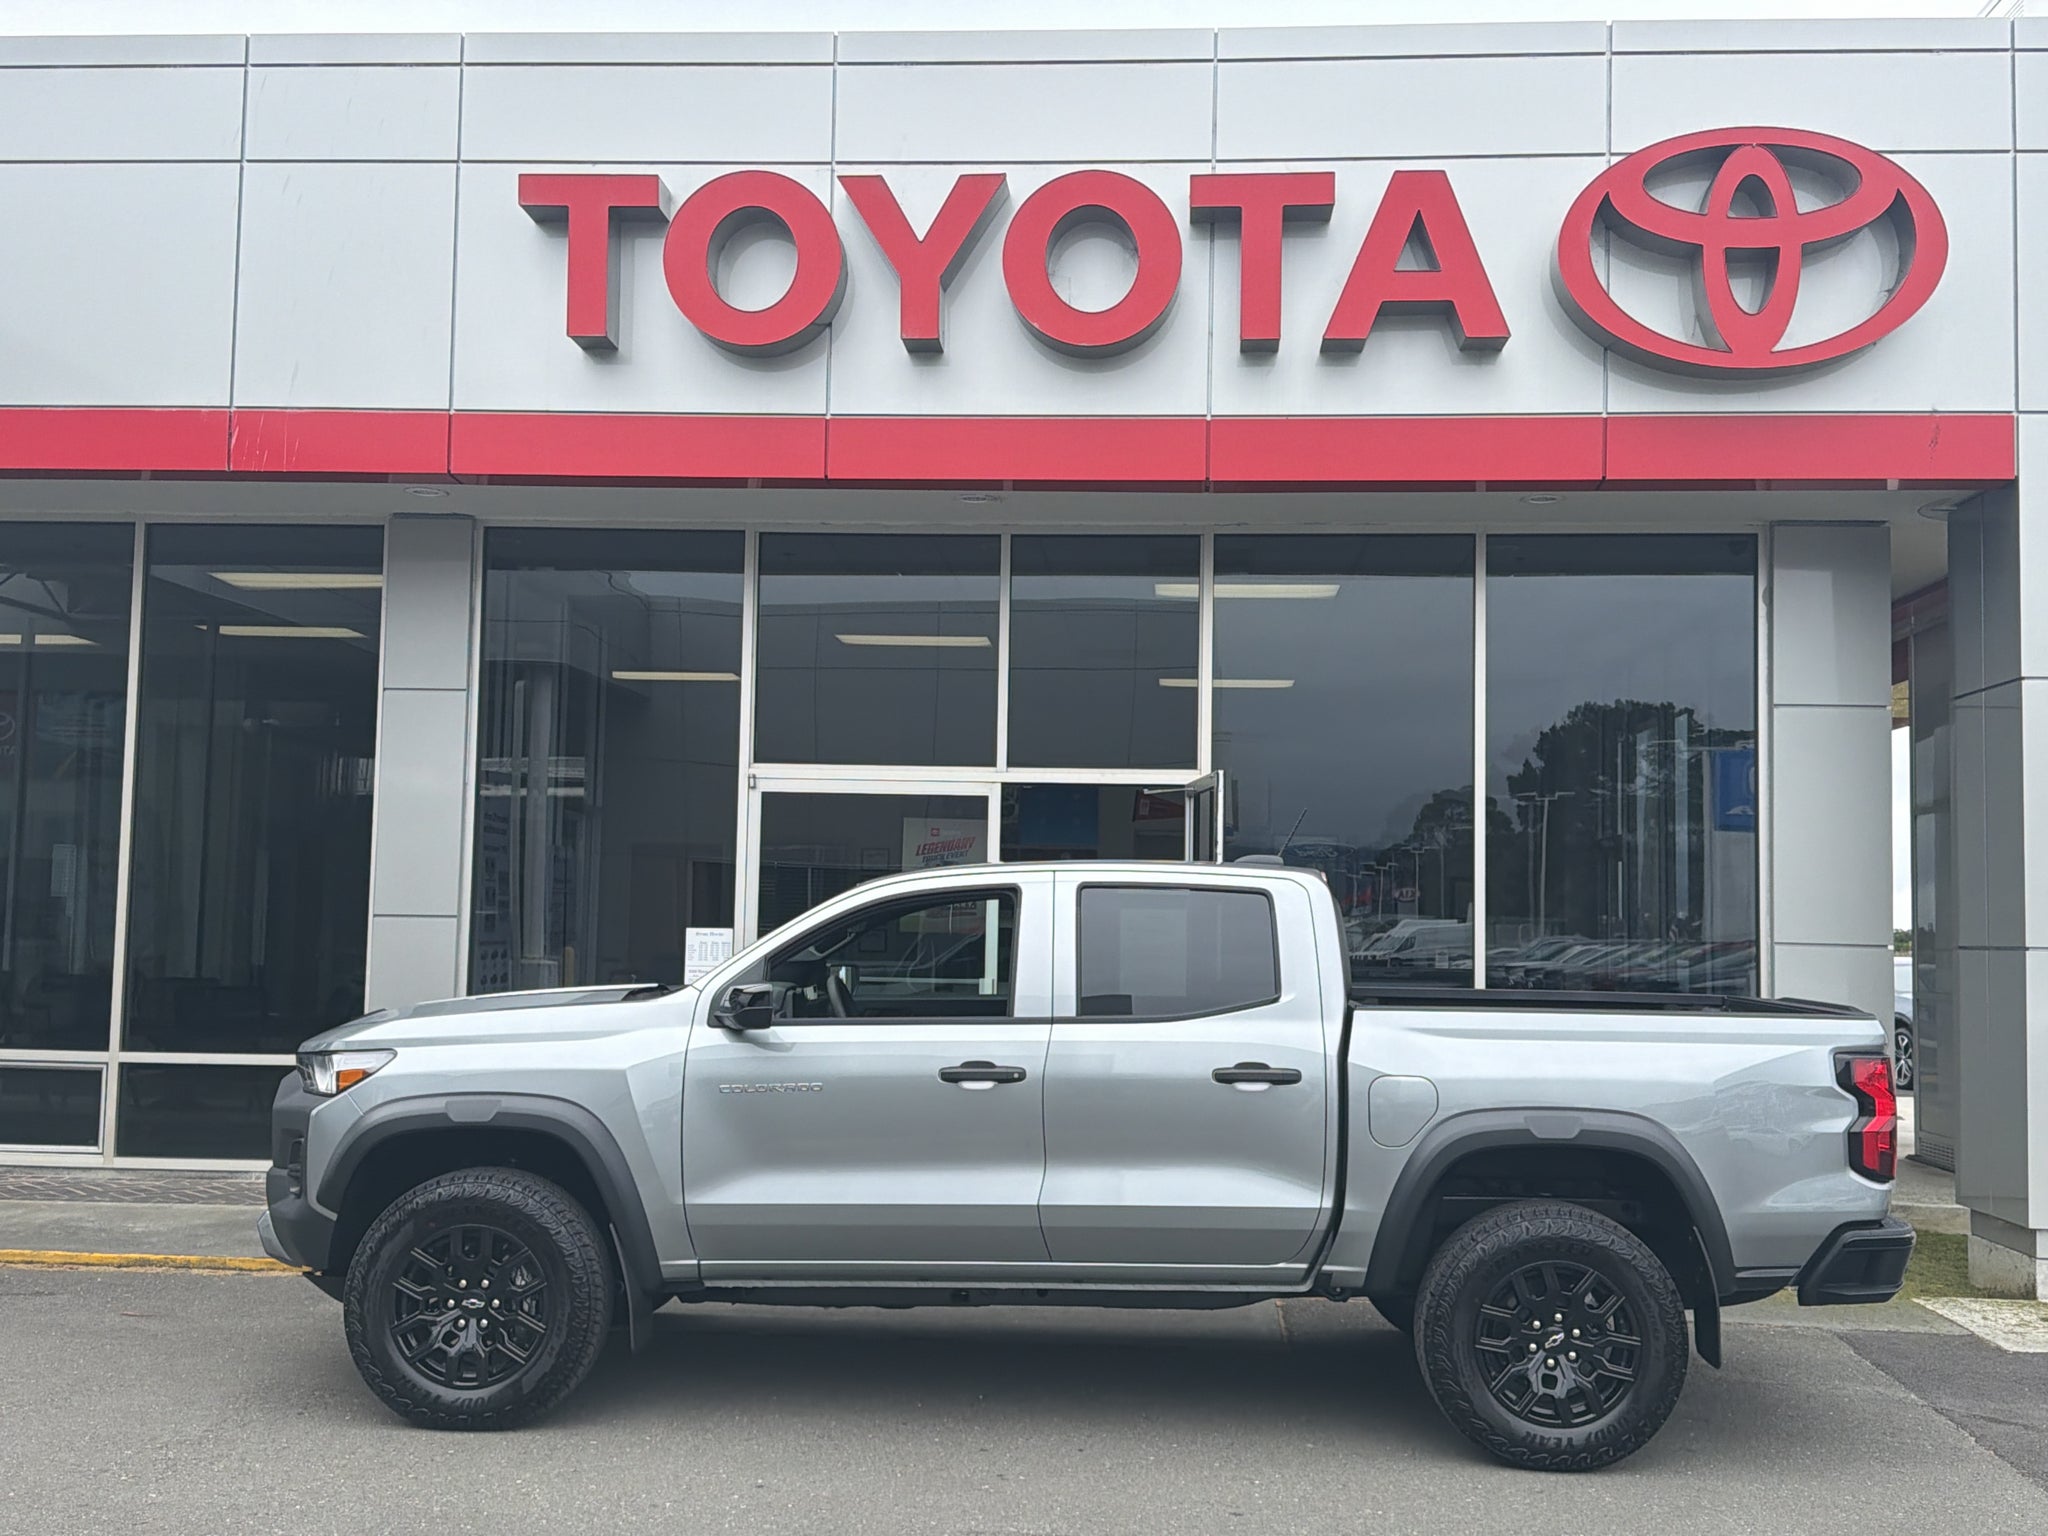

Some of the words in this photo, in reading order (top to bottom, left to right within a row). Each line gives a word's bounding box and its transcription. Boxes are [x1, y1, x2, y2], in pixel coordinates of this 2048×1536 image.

[519, 169, 1511, 351] TOYOTA
[916, 836, 975, 856] LEGENDARY
[719, 1081, 823, 1095] COLORADO
